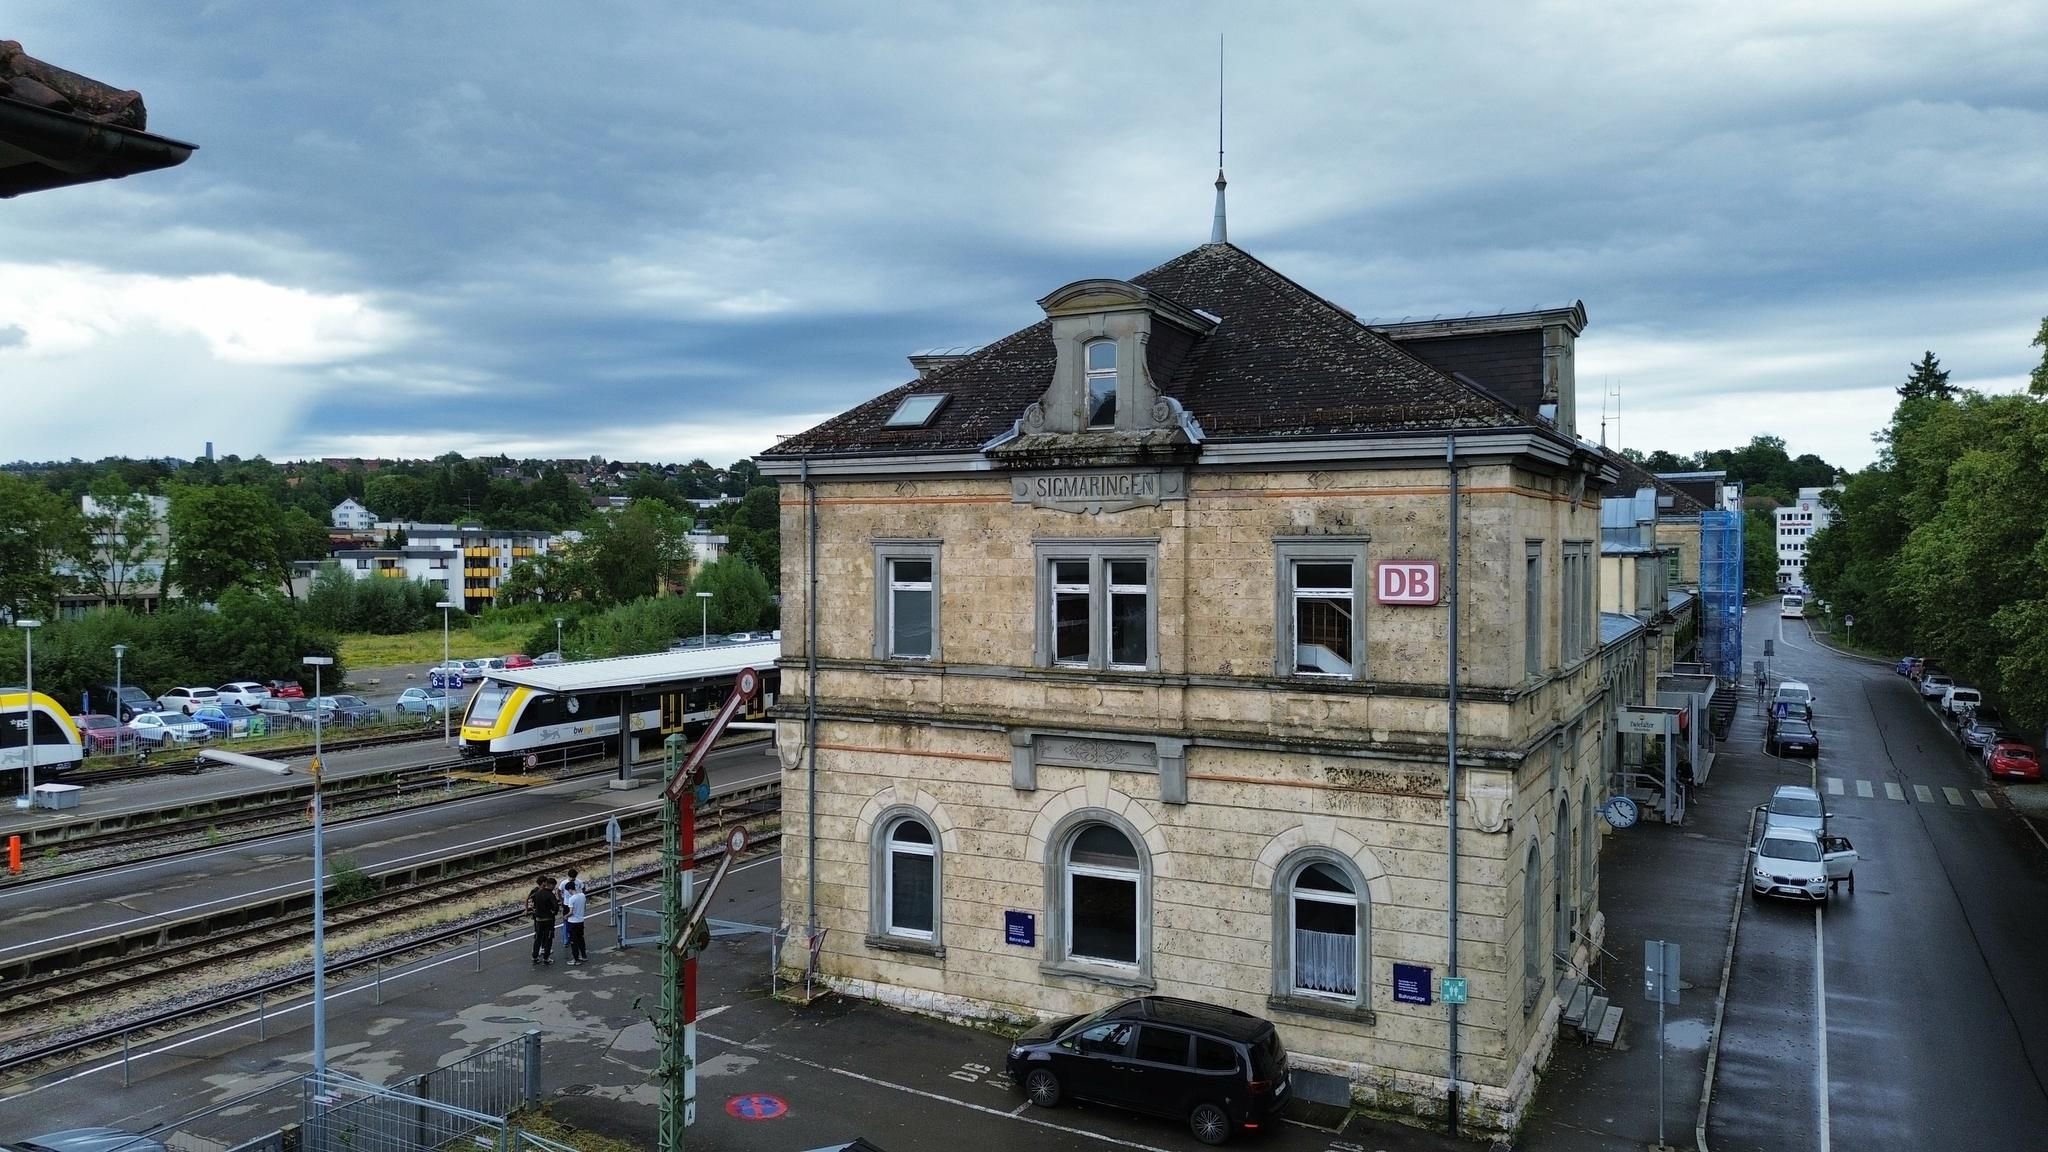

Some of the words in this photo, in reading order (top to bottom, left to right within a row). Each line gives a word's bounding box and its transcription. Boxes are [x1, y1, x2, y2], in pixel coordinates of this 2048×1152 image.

[1036, 473, 1154, 498] SIGMARINGEN
[1384, 568, 1430, 597] DB
[433, 677, 438, 687] 6
[456, 677, 462, 687] 5
[688, 1109, 693, 1121] A
